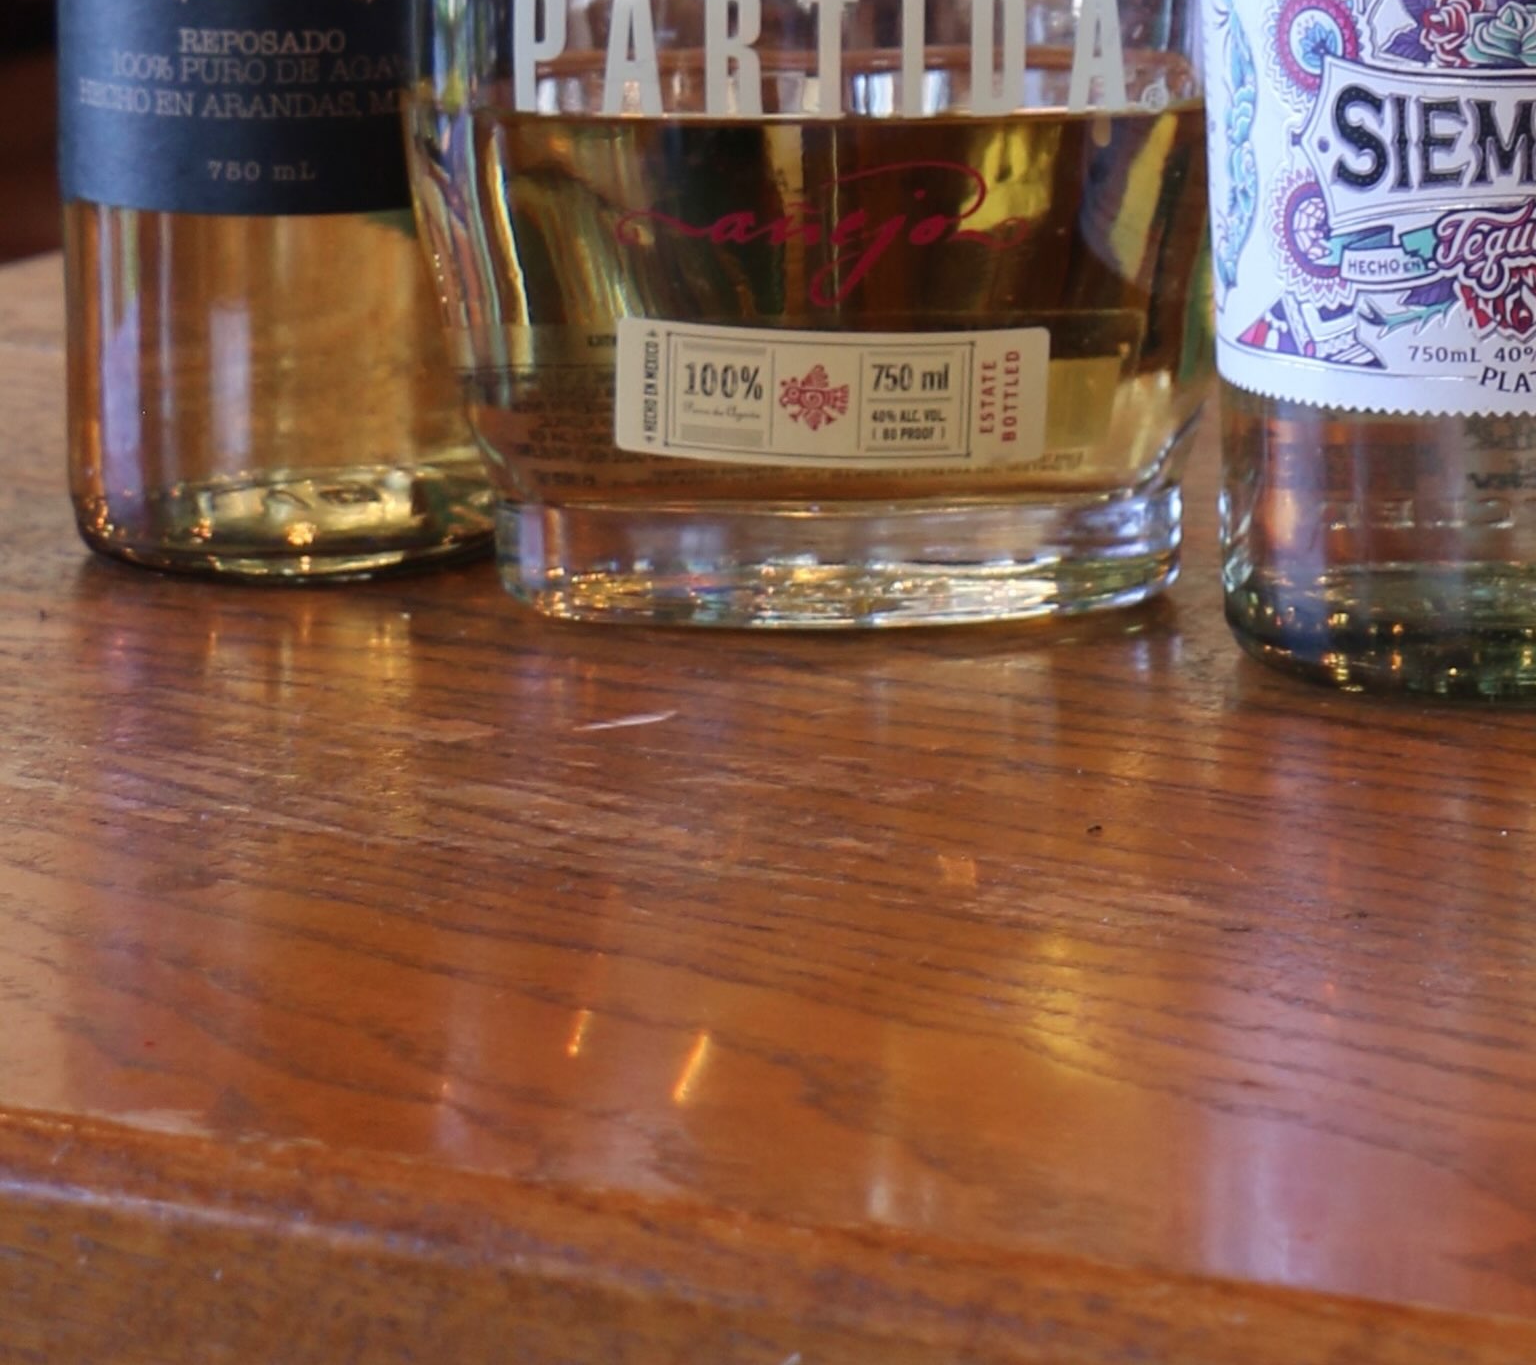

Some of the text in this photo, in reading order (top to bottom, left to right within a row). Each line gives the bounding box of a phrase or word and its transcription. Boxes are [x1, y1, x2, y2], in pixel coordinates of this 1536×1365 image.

[178, 27, 347, 55] REPOSADO
[180, 57, 267, 85] PURO
[274, 58, 321, 84] DE
[155, 91, 195, 118] EN
[1347, 257, 1400, 274] HECHO
[1407, 345, 1482, 364] 750mL
[684, 361, 764, 401] 100%
[871, 362, 950, 392] 750 ml
[978, 360, 998, 435] ESTATE
[1001, 349, 1021, 443] BOTTLED
